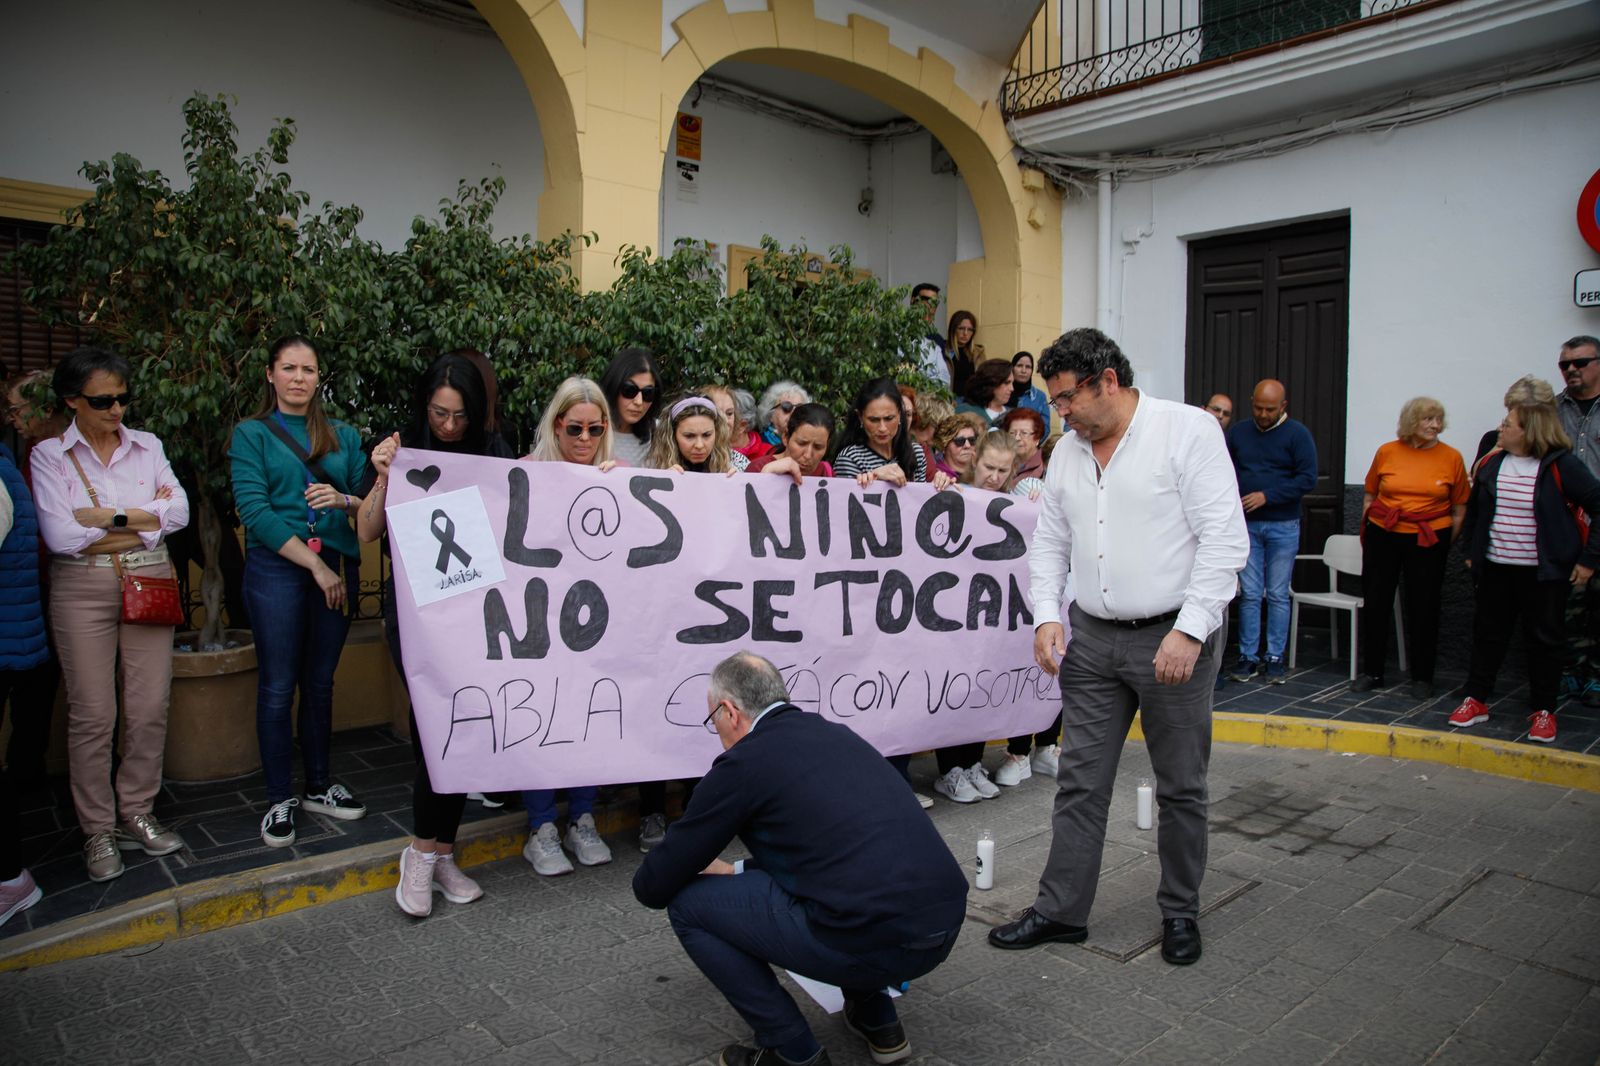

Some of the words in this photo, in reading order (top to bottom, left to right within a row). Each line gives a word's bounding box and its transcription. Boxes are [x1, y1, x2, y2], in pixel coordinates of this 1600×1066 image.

[503, 467, 684, 568] L@S
[483, 577, 609, 660] NO
[676, 580, 803, 644] SE
[442, 677, 622, 760] ABLA
[830, 669, 910, 717] CON
